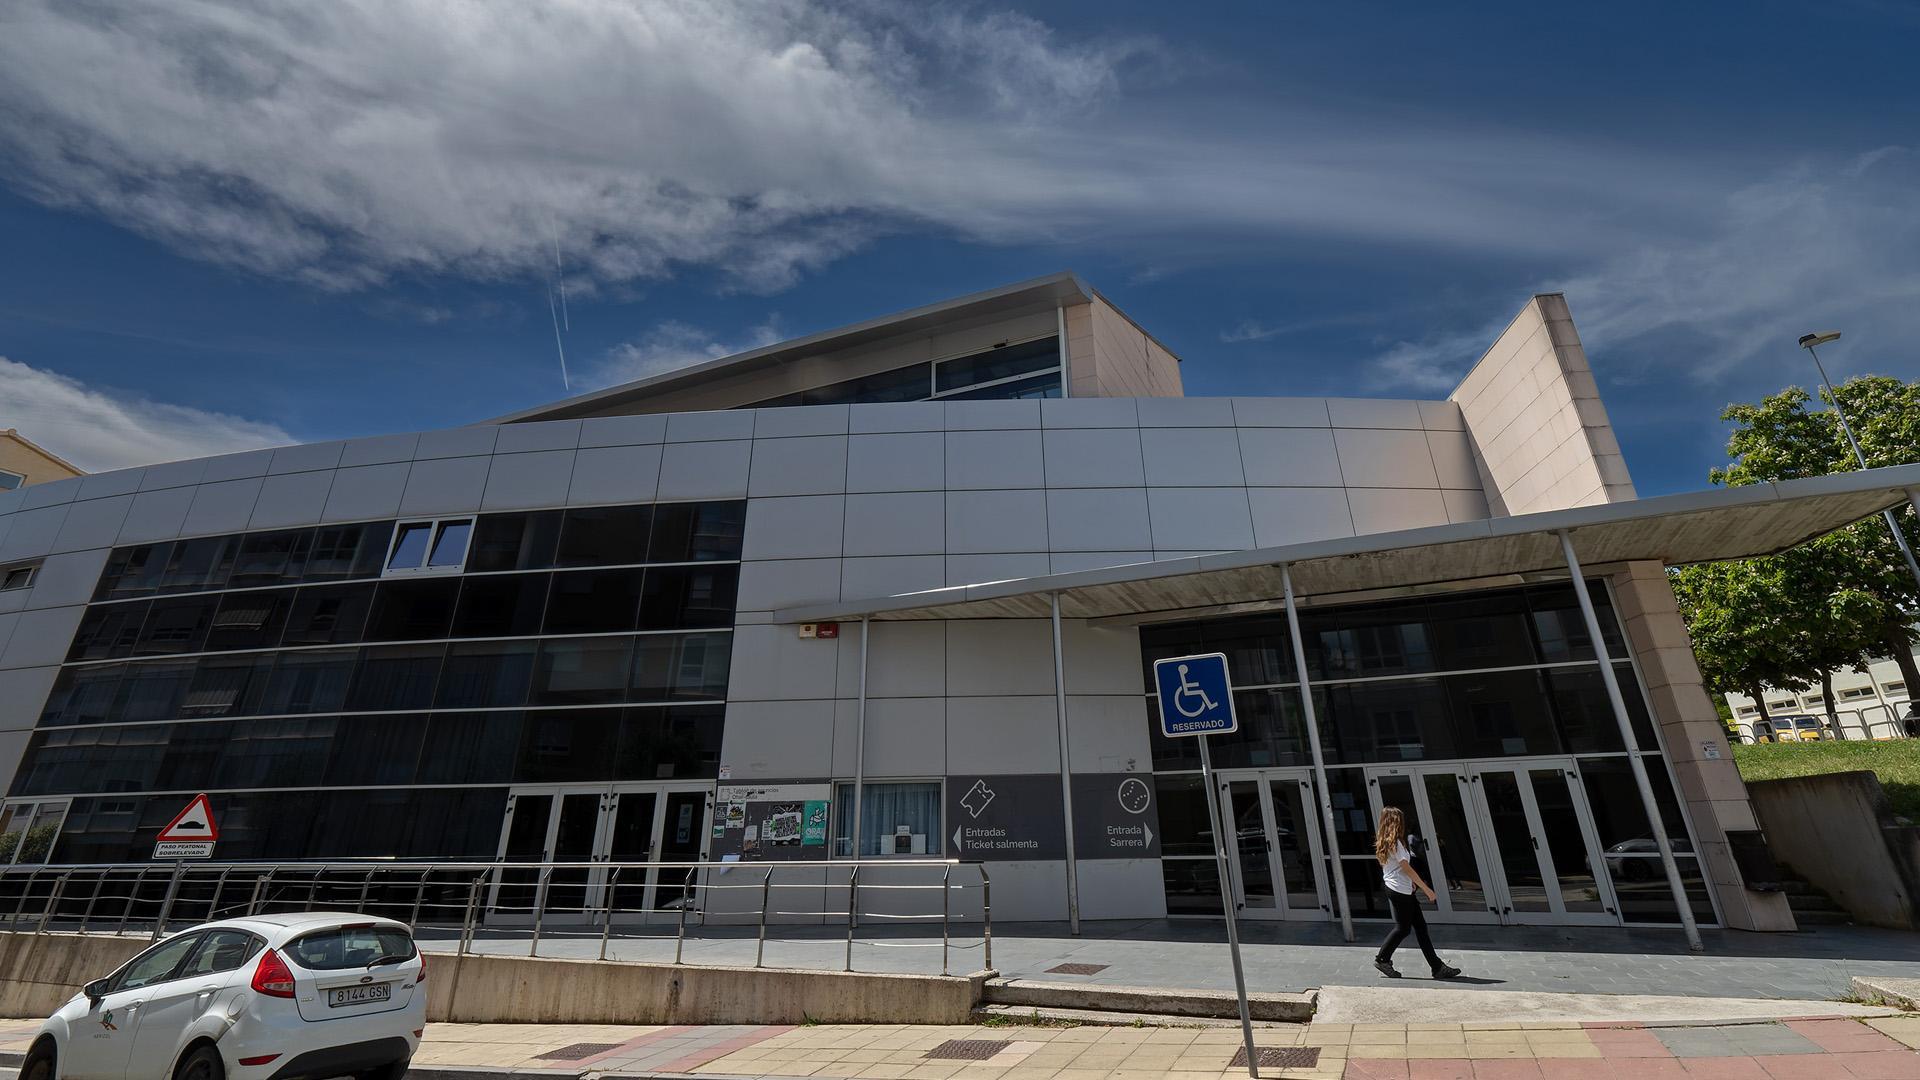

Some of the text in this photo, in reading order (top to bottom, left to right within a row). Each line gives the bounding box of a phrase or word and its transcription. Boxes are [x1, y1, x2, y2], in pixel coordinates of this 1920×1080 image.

[1172, 719, 1225, 732] RESERVADO
[965, 827, 1006, 837] Entradas
[1107, 825, 1142, 835] Entrada
[965, 839, 1039, 849] Ticket salmenta
[1110, 837, 1143, 847] Sarrera
[337, 989, 365, 1002] 8144
[369, 985, 389, 998] GSN
